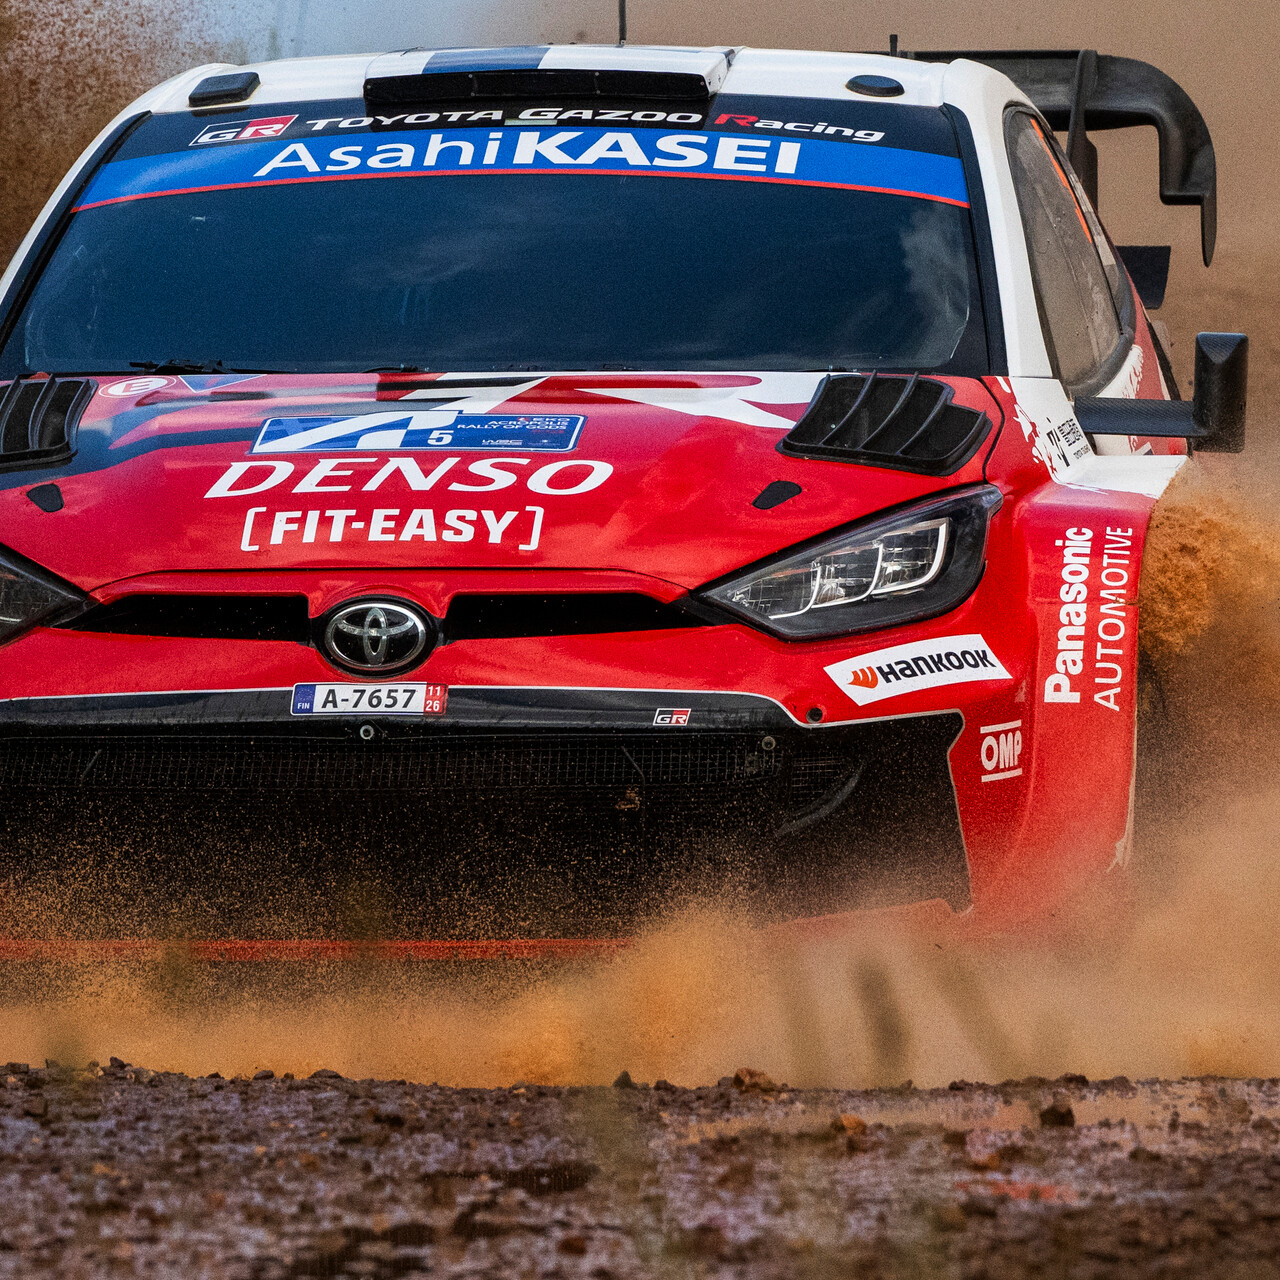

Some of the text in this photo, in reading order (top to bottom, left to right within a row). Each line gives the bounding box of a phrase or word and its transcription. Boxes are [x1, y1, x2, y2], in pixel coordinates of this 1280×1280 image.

[306, 107, 886, 143] TOYOTA GAZOO Racing
[427, 430, 455, 446] 5
[203, 456, 614, 498] DENSO
[1043, 526, 1094, 704] Panasonic
[1093, 525, 1133, 712] AUTOMOTIVE
[320, 688, 417, 709] A-7657
[425, 700, 440, 712] 26
[427, 686, 441, 696] 11
[980, 729, 1023, 771] OMP
